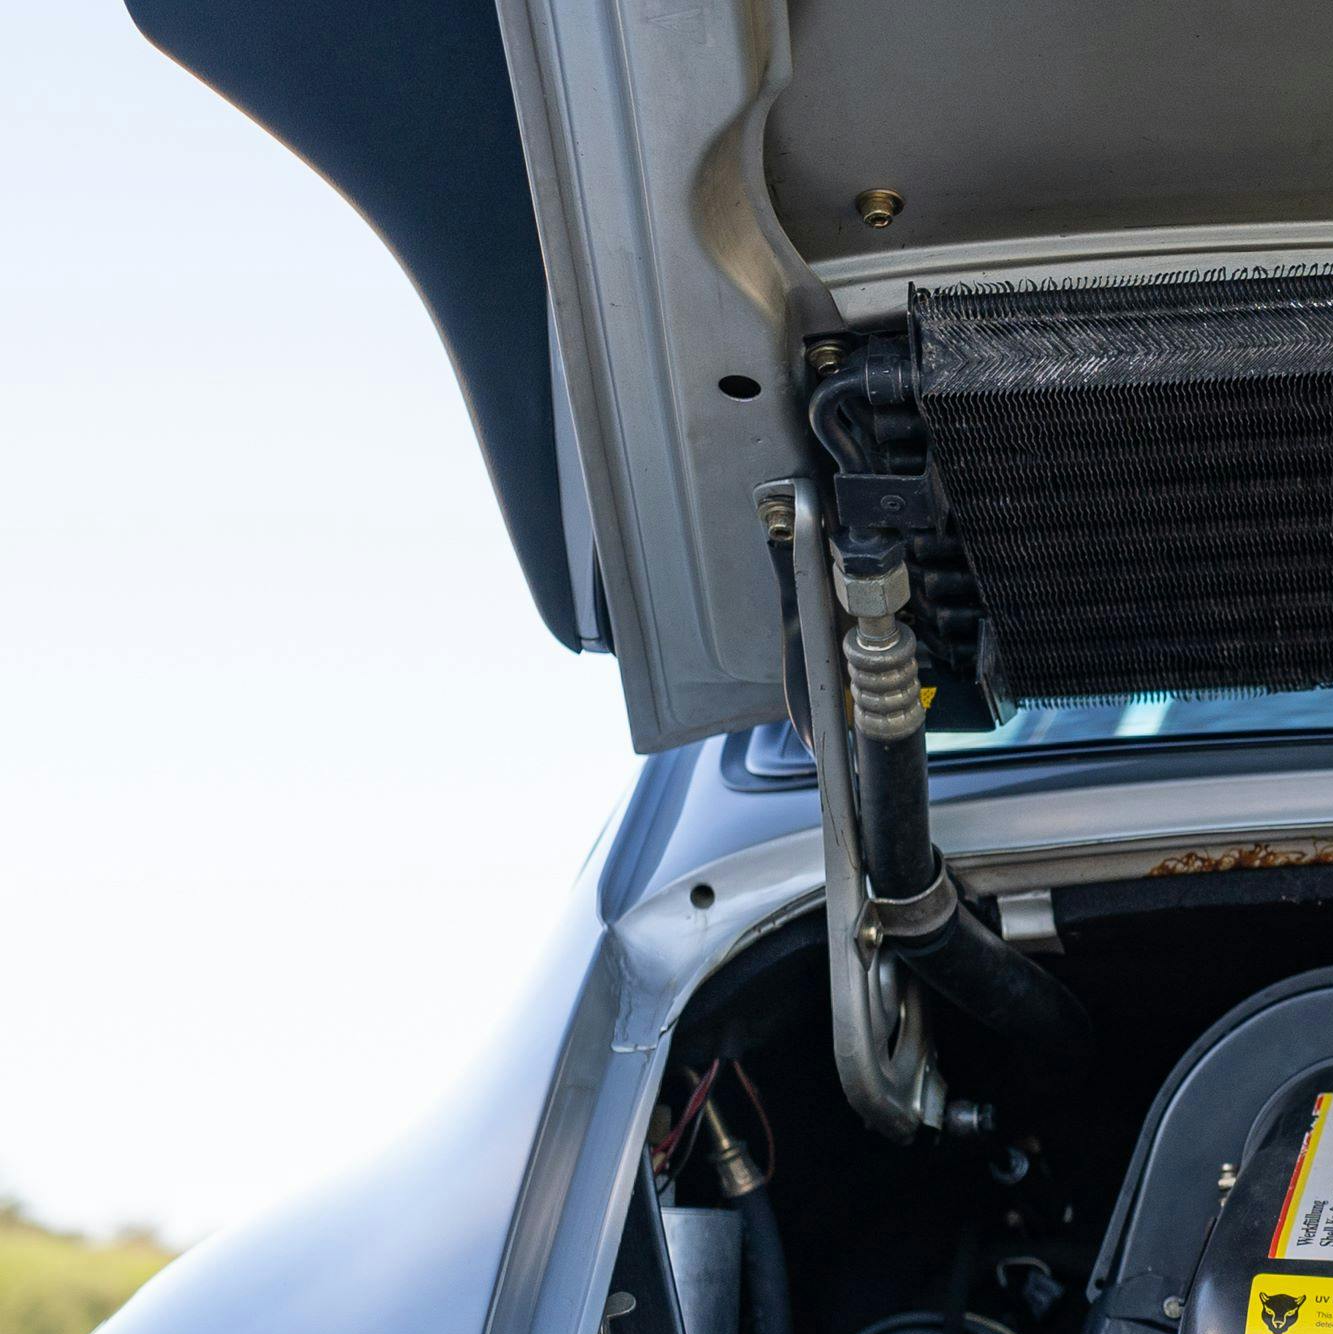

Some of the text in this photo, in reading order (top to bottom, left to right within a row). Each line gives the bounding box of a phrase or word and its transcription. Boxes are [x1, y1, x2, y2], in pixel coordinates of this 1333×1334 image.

[1297, 1198, 1328, 1246] Werkfüllung
[1315, 1295, 1330, 1304] UV
[1316, 1311, 1333, 1319] This
